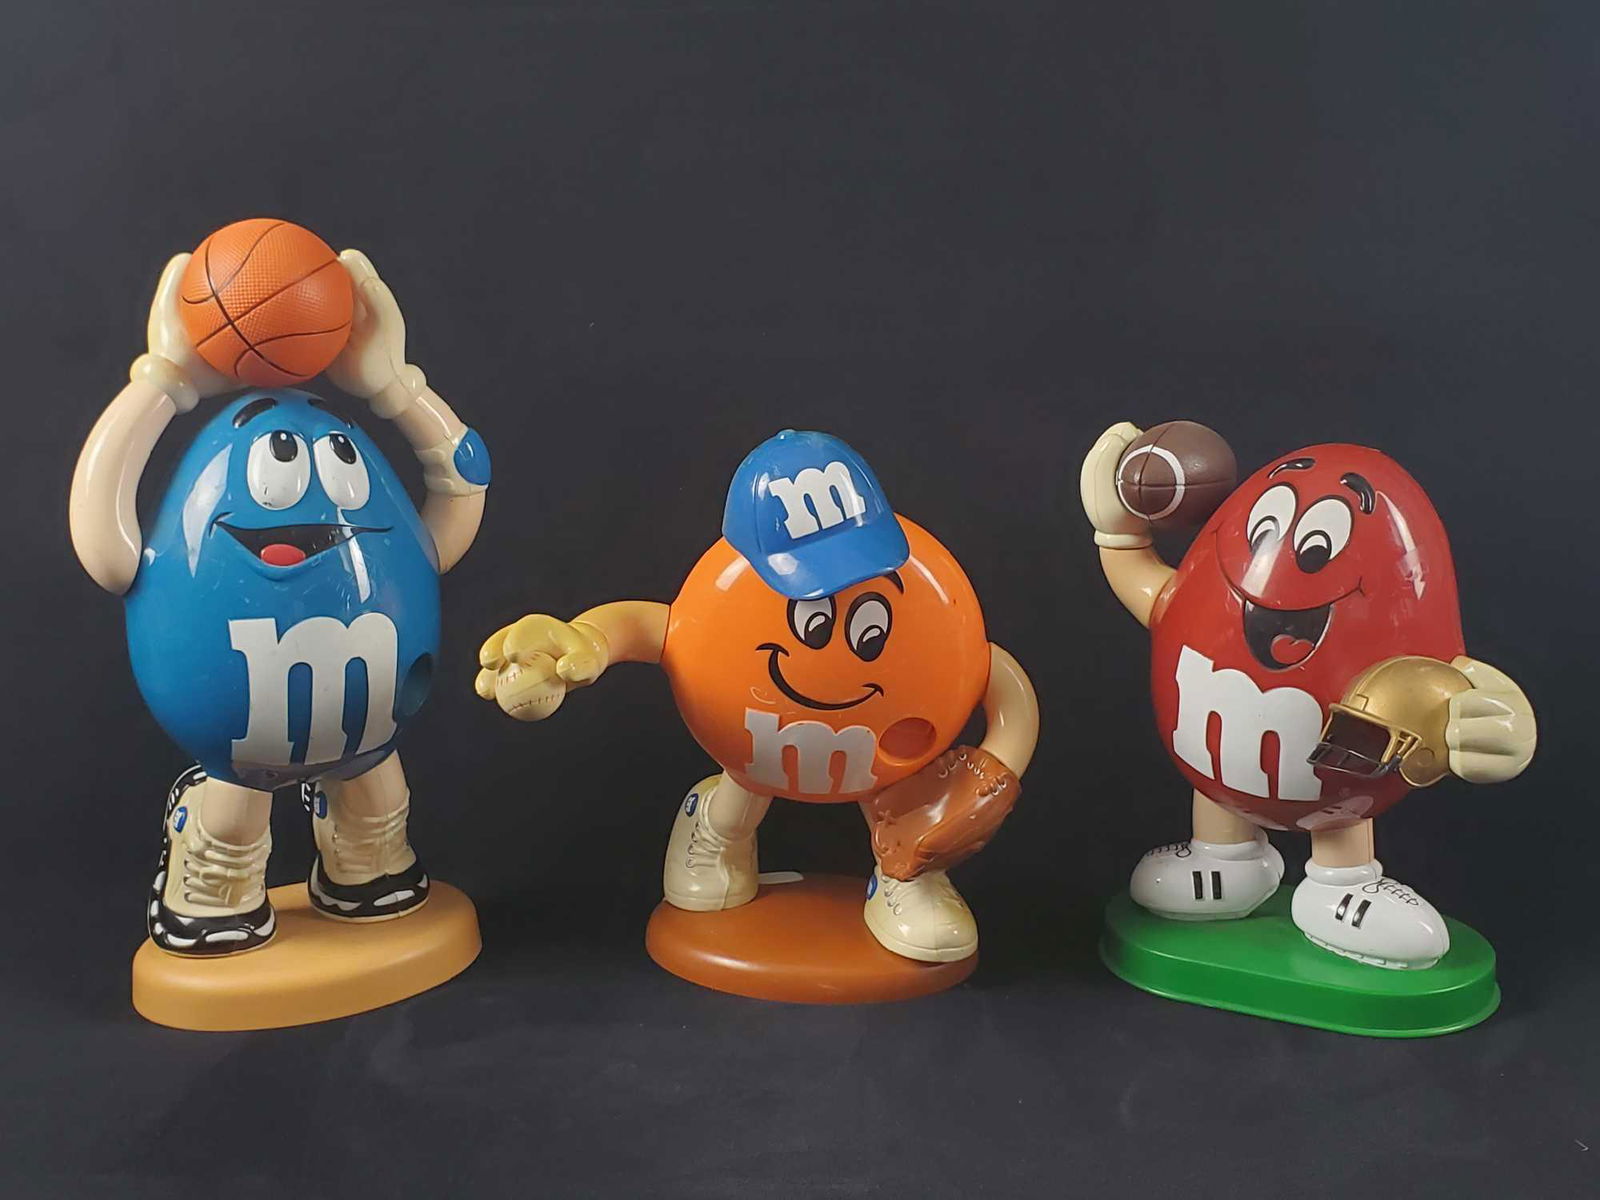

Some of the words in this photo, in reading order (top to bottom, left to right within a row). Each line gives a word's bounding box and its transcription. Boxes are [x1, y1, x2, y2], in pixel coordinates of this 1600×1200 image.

[768, 461, 865, 539] m
[228, 612, 398, 765] m
[1172, 645, 1323, 801] m
[744, 708, 878, 794] m
